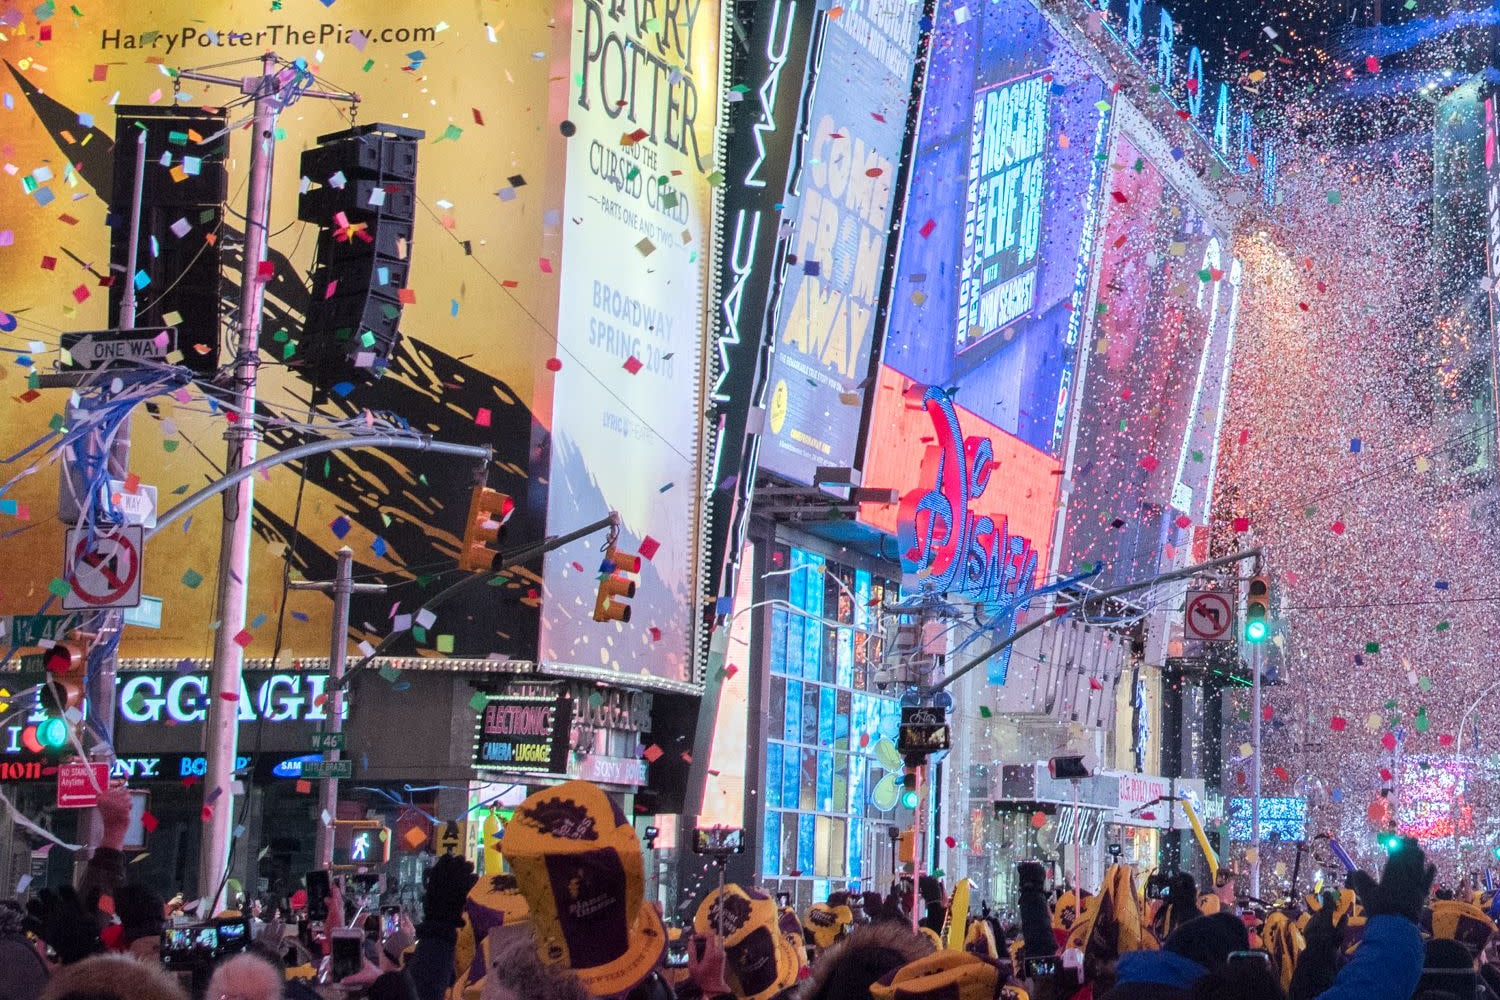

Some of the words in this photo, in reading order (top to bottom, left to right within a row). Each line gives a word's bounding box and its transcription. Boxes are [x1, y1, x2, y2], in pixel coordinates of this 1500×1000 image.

[589, 138, 643, 200] CURSED
[642, 145, 658, 172] THE
[811, 113, 893, 232] COME
[600, 195, 622, 221] PARTS
[623, 210, 639, 229] ONE
[639, 216, 656, 240] AND
[956, 262, 972, 346] DICK
[964, 100, 984, 248] CLARK'S
[797, 186, 883, 306] FROM
[592, 279, 674, 344] BROADWAY
[781, 272, 871, 380] AWAY
[94, 342, 124, 358] ONE
[128, 341, 161, 357] WAY
[588, 315, 642, 362] SPRING
[311, 735, 320, 749] W
[323, 735, 337, 748] 46
[482, 742, 512, 762] CAMERA
[515, 743, 550, 762] LUGGAGE
[61, 767, 70, 777] NO
[593, 759, 622, 778] SONY
